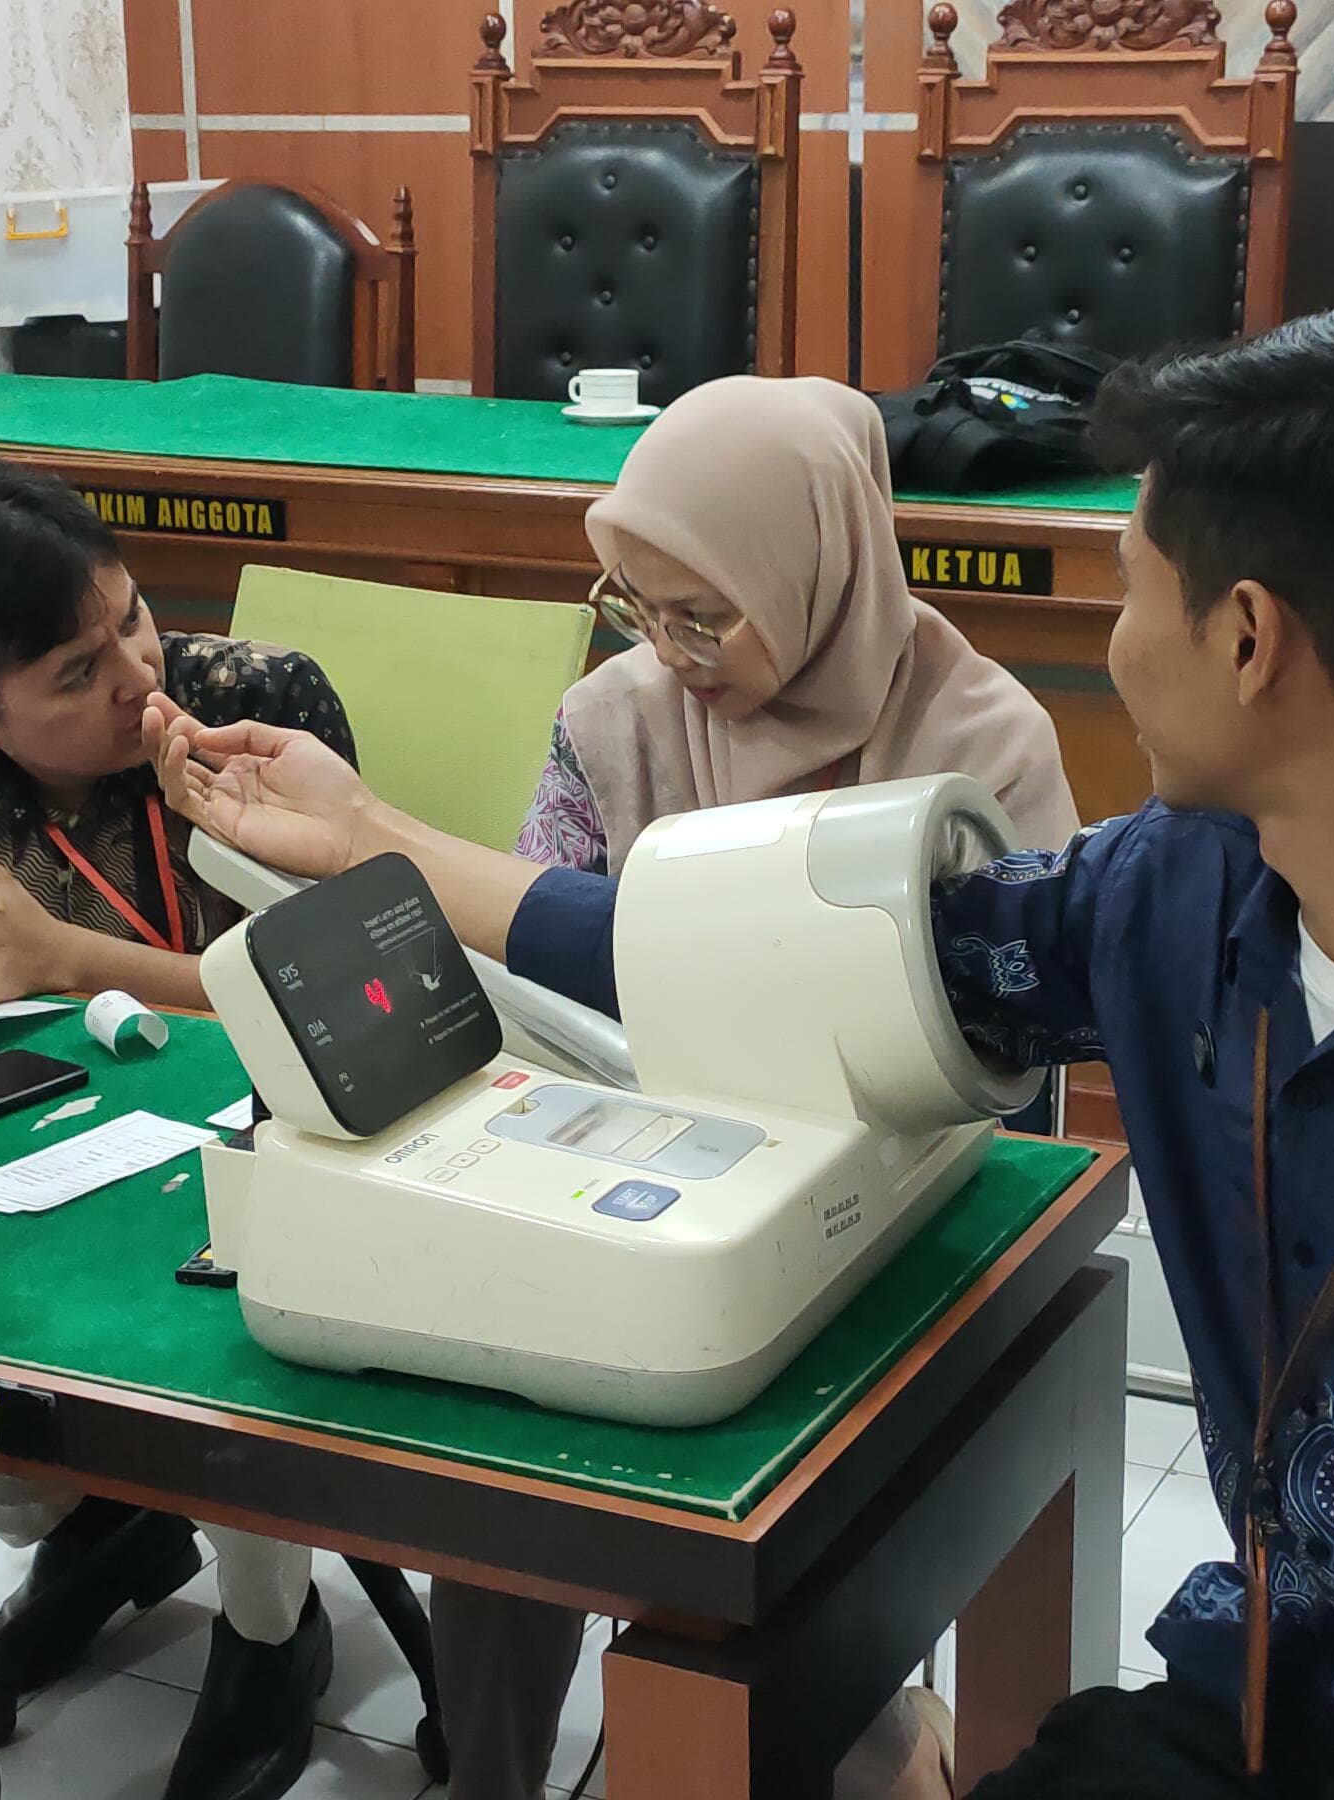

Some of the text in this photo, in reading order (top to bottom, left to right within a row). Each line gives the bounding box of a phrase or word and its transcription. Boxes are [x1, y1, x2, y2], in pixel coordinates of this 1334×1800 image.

[84, 491, 274, 535] AKIM ANGGOTA
[911, 547, 1022, 587] KETUA
[277, 962, 299, 983] SYS
[307, 1018, 328, 1038] DIA
[384, 1132, 441, 1165] OMRON
